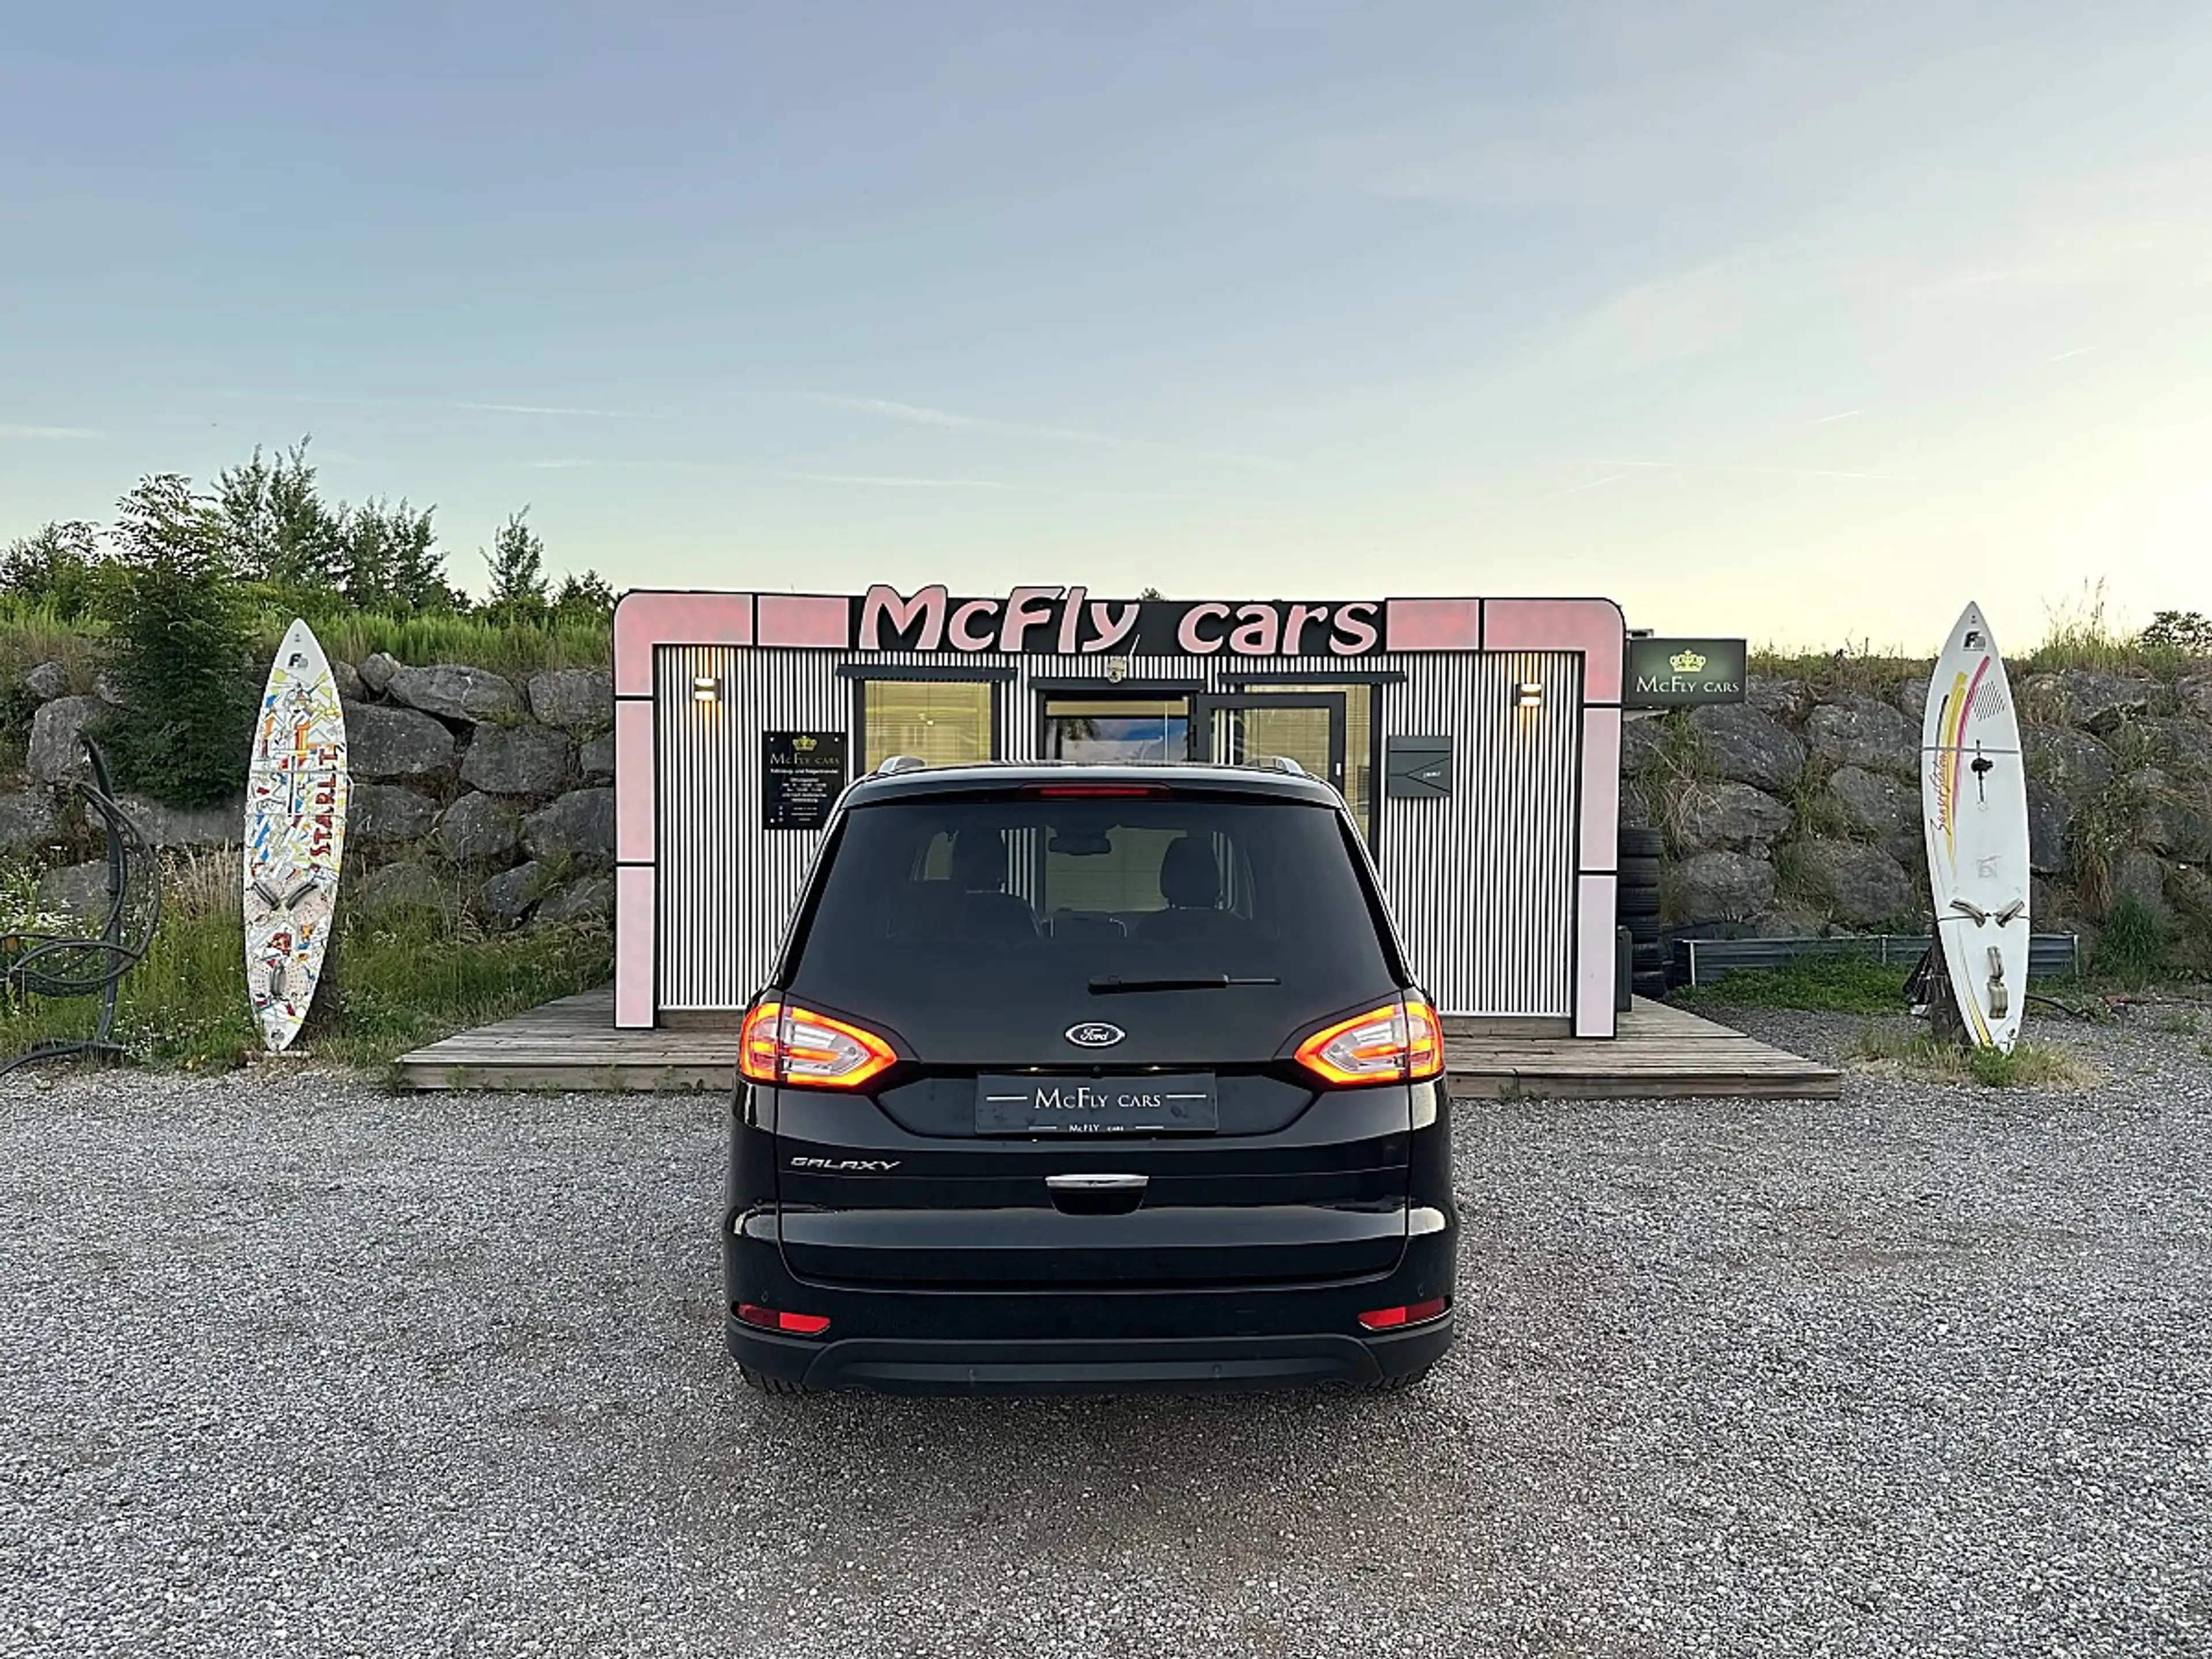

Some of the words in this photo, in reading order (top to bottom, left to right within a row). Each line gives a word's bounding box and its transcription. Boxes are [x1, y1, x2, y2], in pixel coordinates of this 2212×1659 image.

[858, 584, 1141, 653] McFly
[1176, 601, 1379, 656] cars
[310, 745, 339, 857] STARLT
[1080, 1027, 1109, 1041] Ford
[791, 1157, 903, 1172] GALAXY
